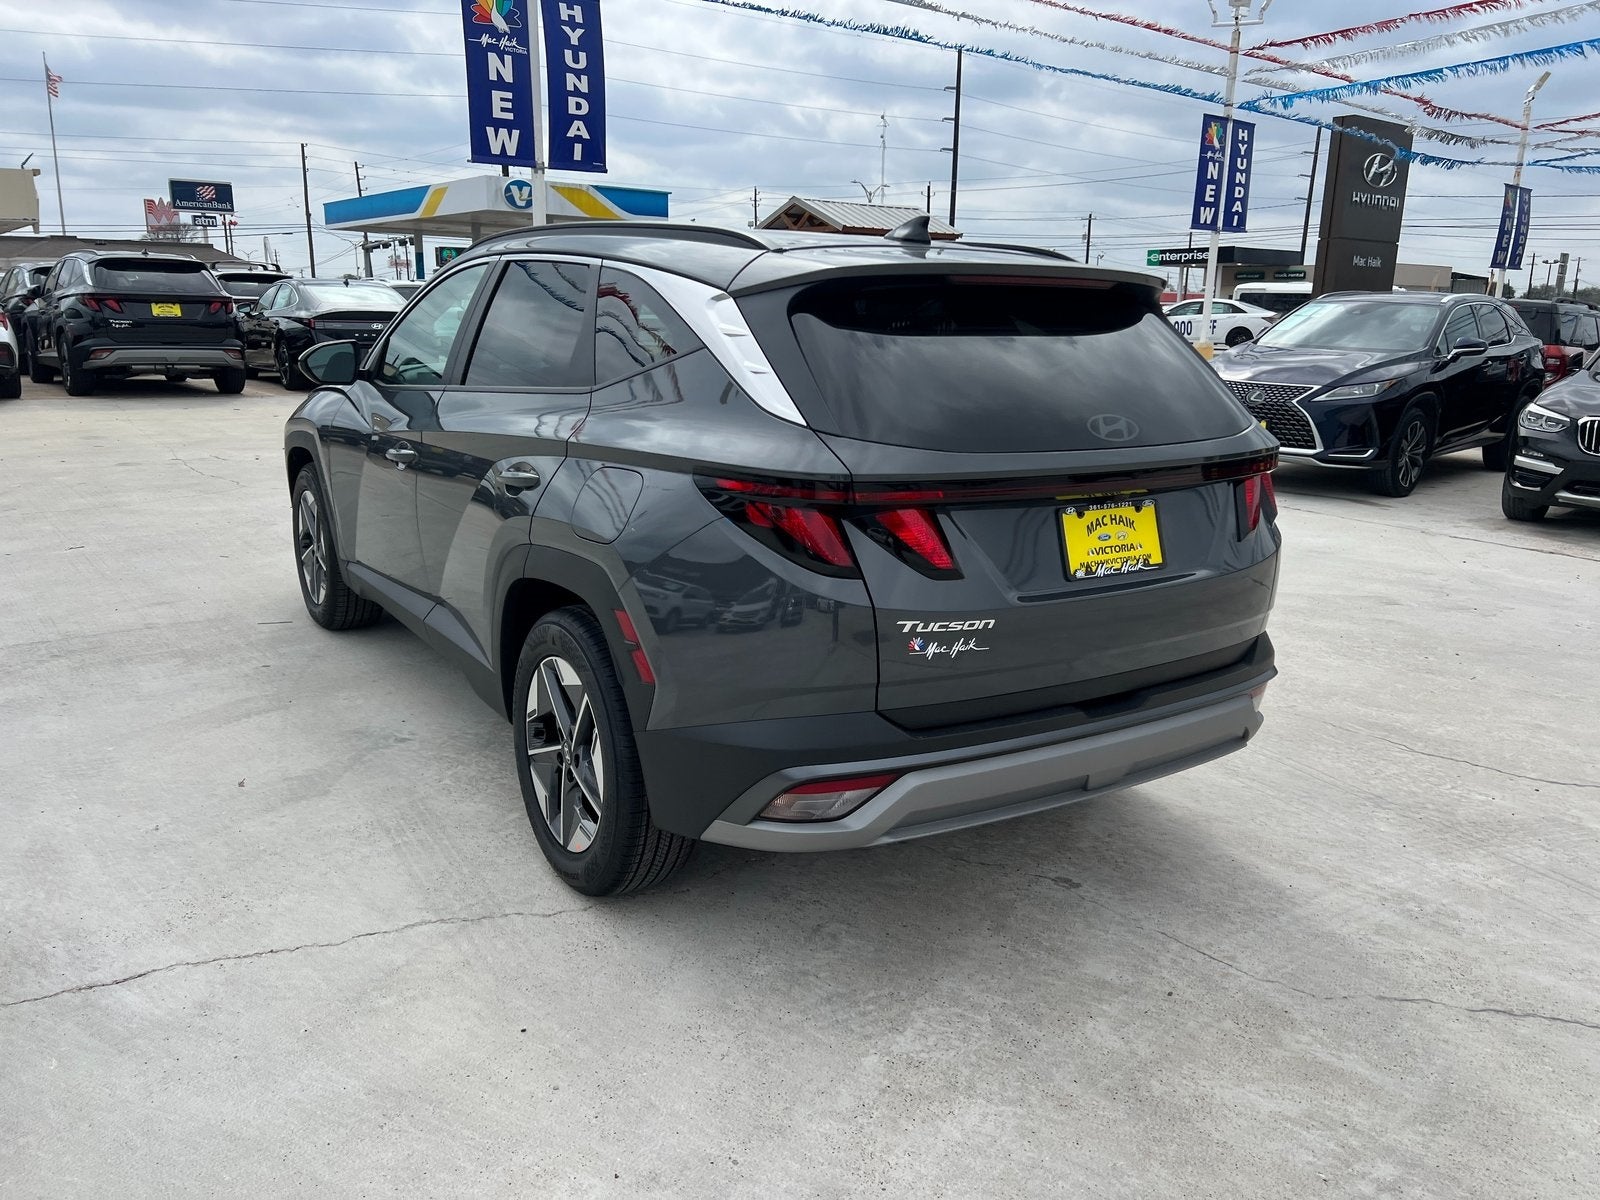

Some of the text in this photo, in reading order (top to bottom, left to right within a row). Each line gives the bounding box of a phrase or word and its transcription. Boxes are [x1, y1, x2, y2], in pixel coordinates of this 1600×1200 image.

[474, 33, 527, 50] Mac Haik
[504, 47, 528, 55] VICTORIA
[558, 2, 591, 161] HYUNDAI
[486, 52, 520, 157] NEW
[1231, 128, 1248, 227] HYUNDAI
[1199, 161, 1220, 225] NEW
[1352, 191, 1400, 208] HYUNDAI
[194, 216, 217, 226] atm
[1515, 193, 1529, 265] HYUNDAI
[1496, 217, 1512, 264] NEW
[1149, 250, 1209, 264] enterprise
[1352, 255, 1382, 268] Mac Haik
[1086, 515, 1108, 537] MAC
[1109, 513, 1137, 532] HAIK
[1093, 543, 1136, 556] VICTORIA
[1091, 560, 1160, 578] Mac Haik
[918, 637, 990, 660] Mac Haik
